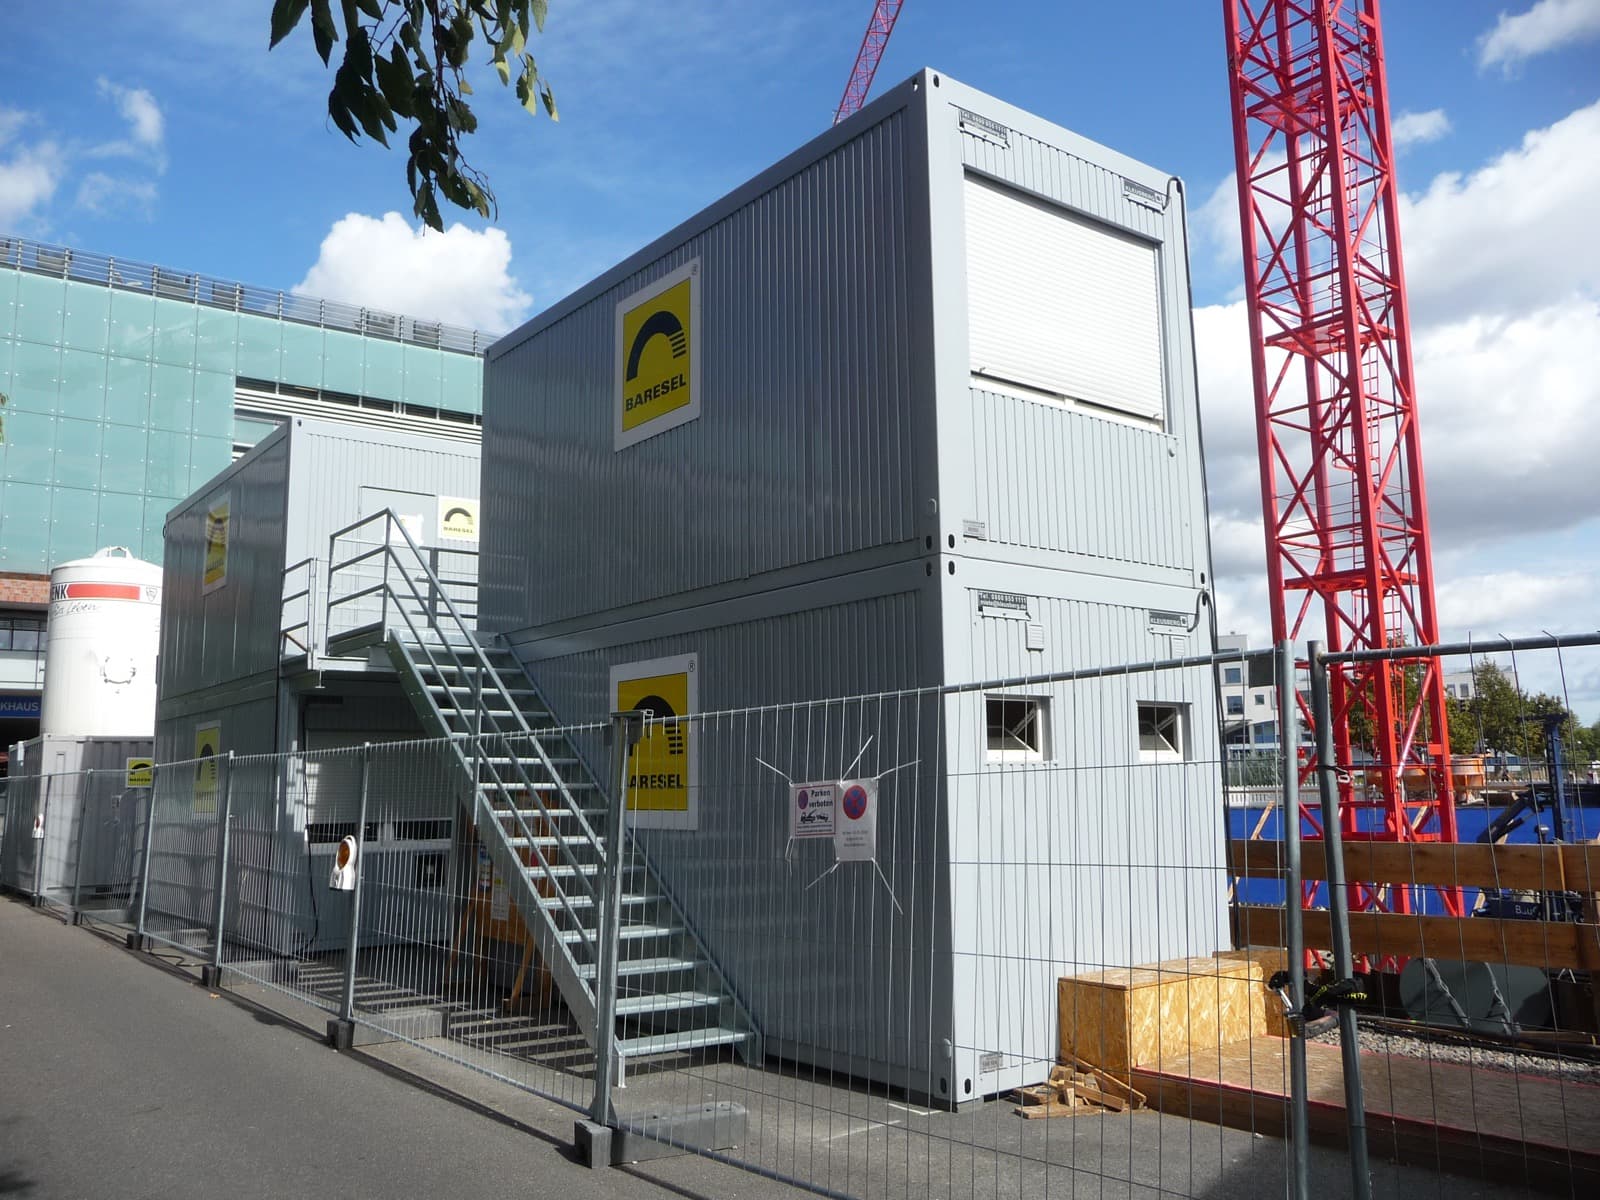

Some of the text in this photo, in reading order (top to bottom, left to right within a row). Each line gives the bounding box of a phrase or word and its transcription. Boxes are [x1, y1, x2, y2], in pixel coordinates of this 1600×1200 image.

[625, 373, 687, 412] BARESEL
[628, 774, 684, 789] ARESEL
[809, 800, 833, 808] verboten
